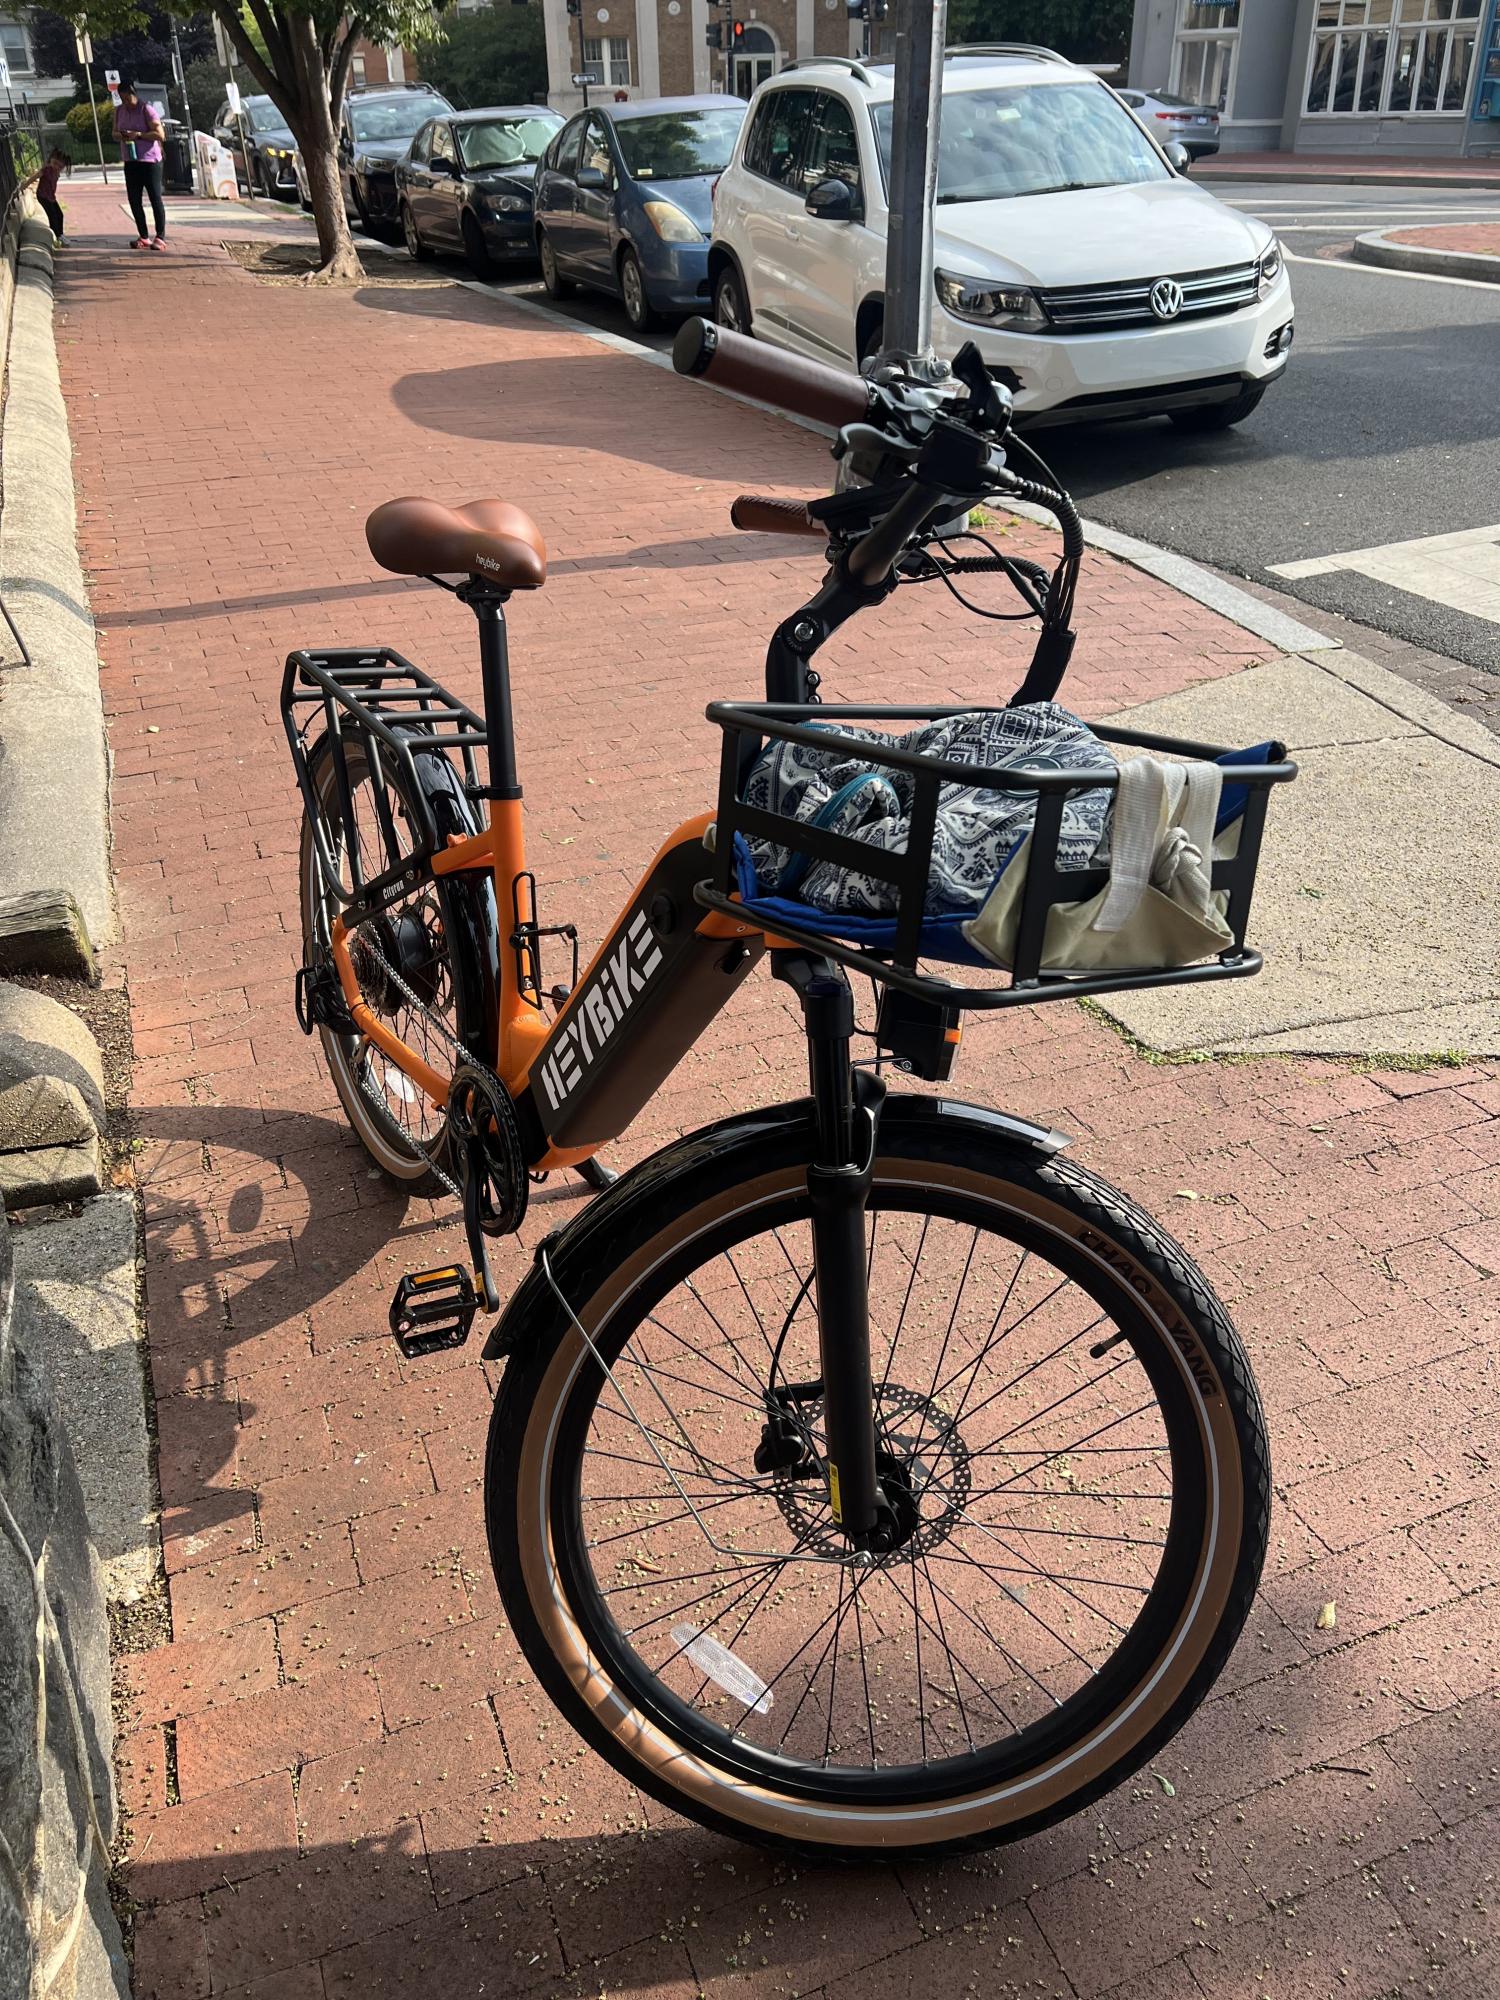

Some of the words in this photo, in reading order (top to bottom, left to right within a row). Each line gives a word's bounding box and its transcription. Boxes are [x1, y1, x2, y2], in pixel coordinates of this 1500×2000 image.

[475, 553, 501, 571] heybike
[1079, 1230, 1152, 1294] CHAO
[1168, 1321, 1217, 1396] YANG
